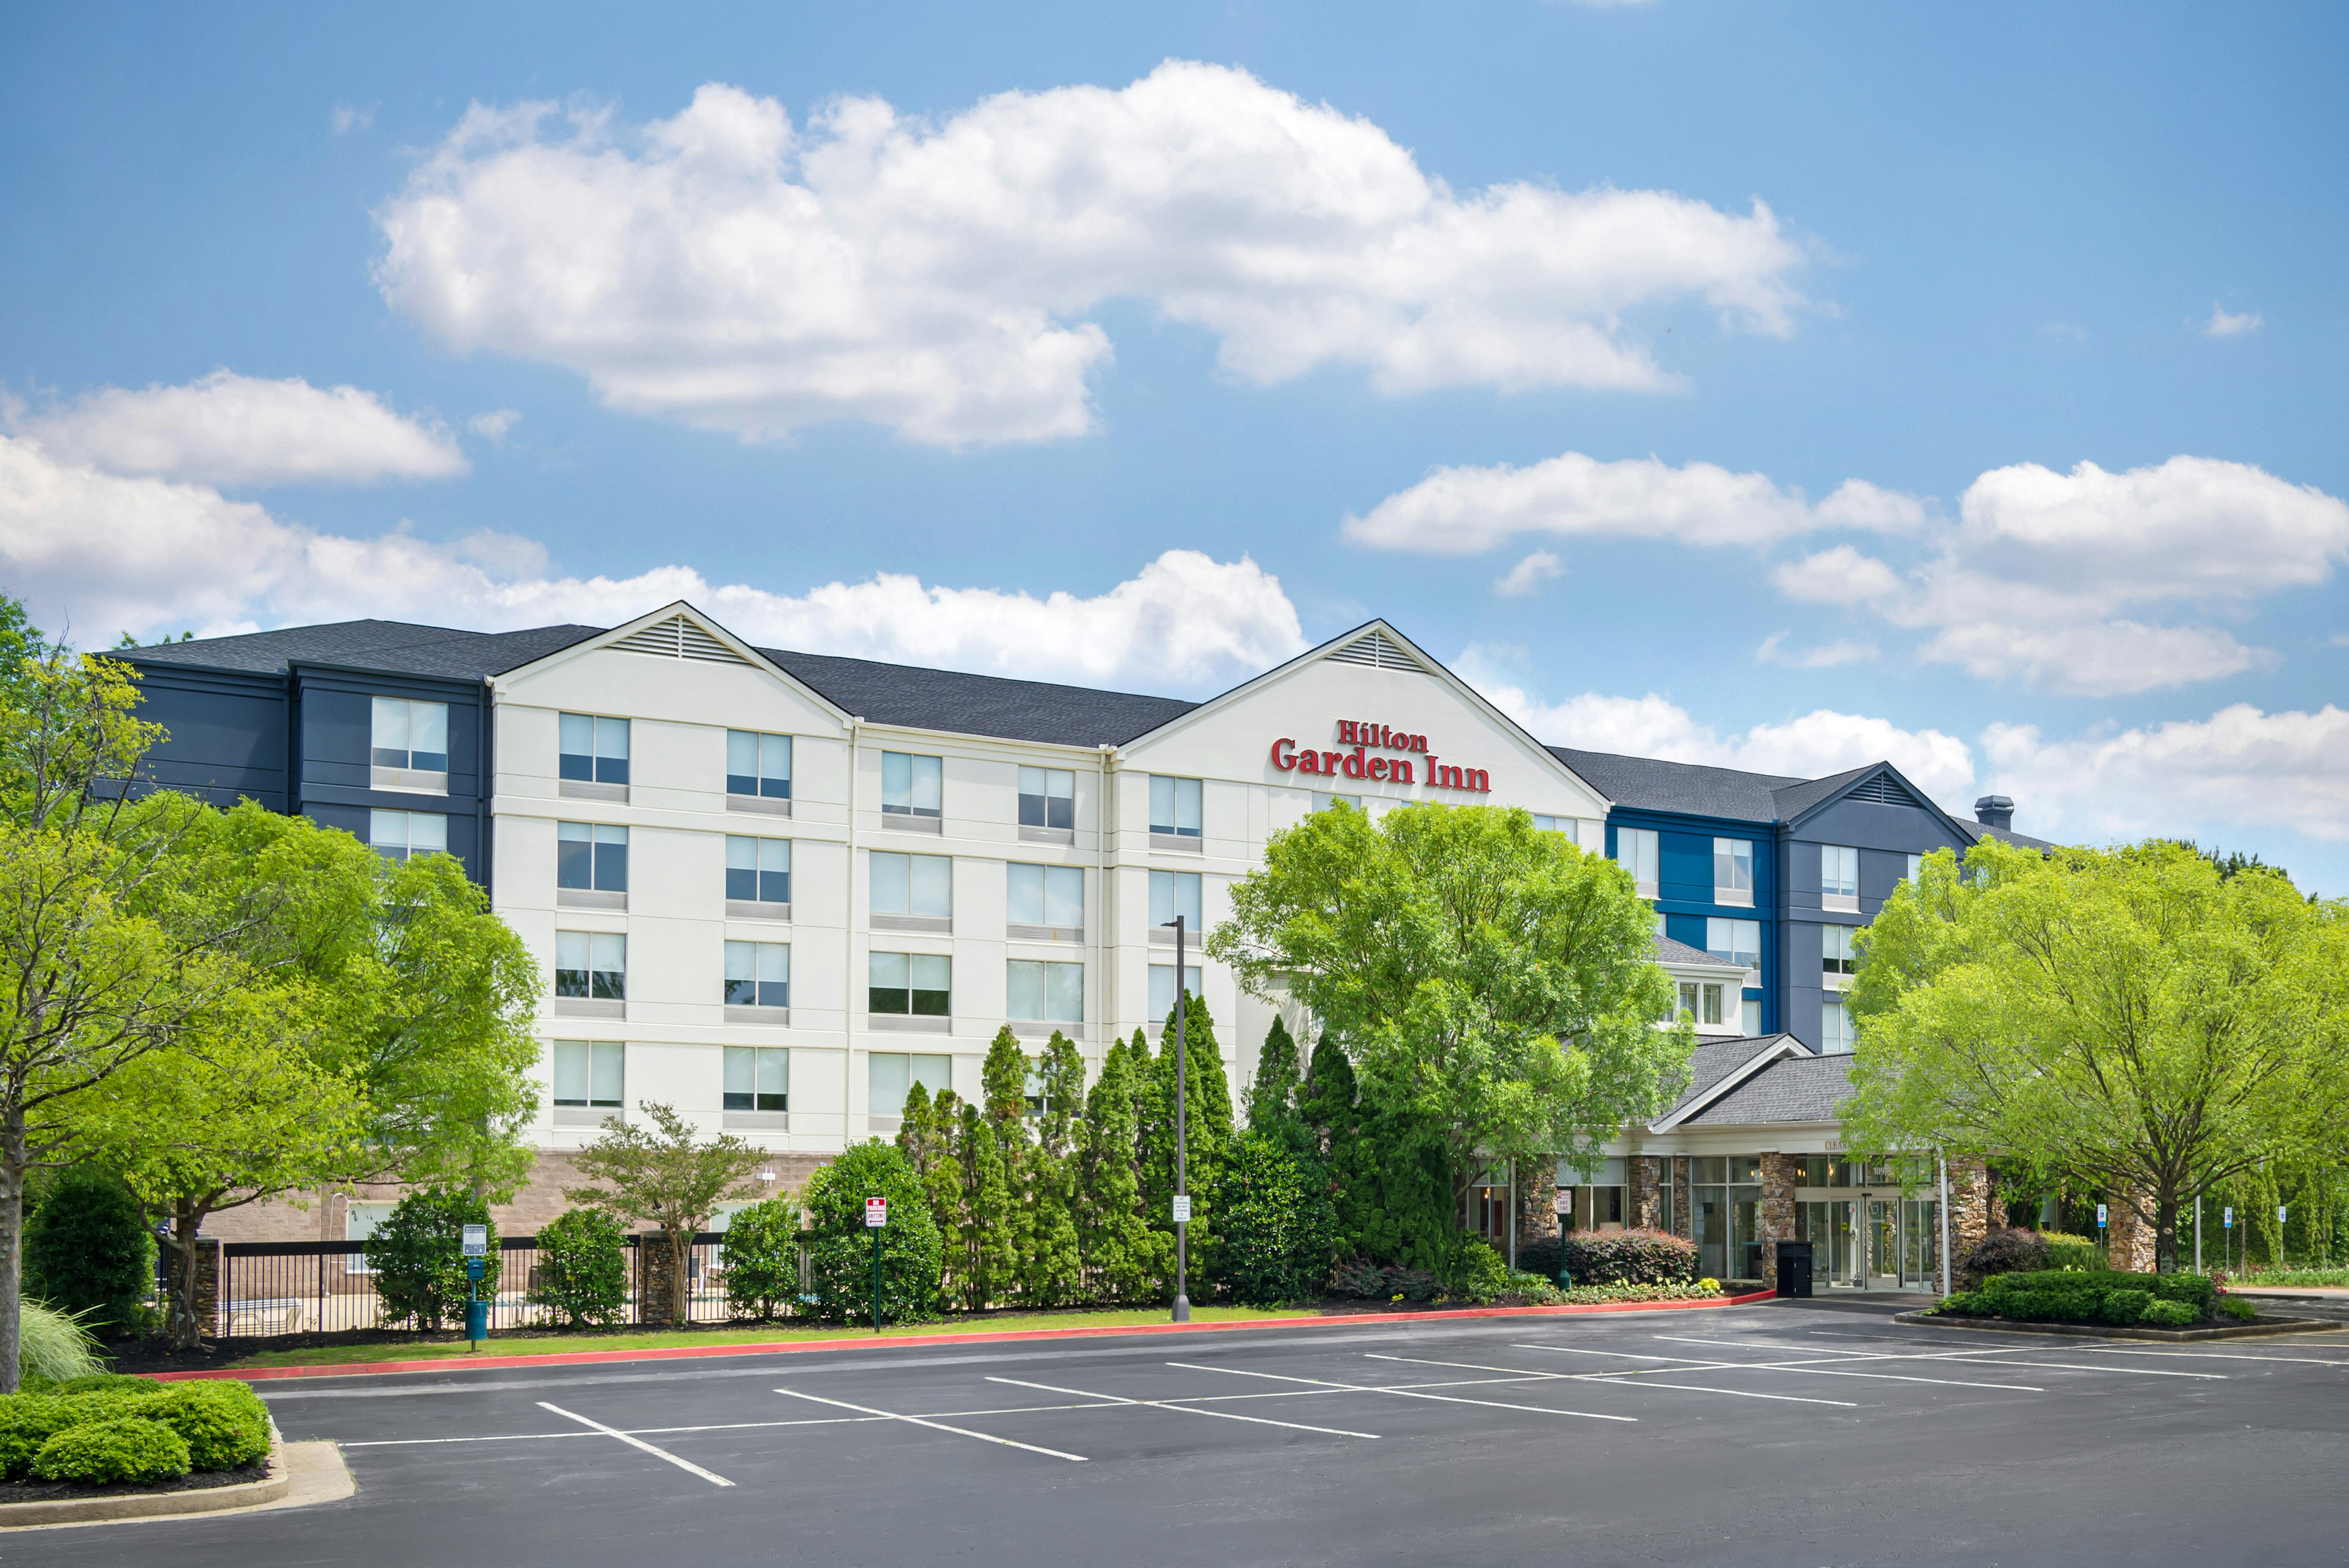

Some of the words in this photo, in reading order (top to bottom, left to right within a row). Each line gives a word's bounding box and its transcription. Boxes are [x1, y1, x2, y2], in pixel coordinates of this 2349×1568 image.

[1337, 719, 1428, 753] Hilton
[1271, 738, 1415, 784] Garden
[1424, 755, 1491, 793] Inn
[1825, 1141, 1850, 1149] CLEAR
